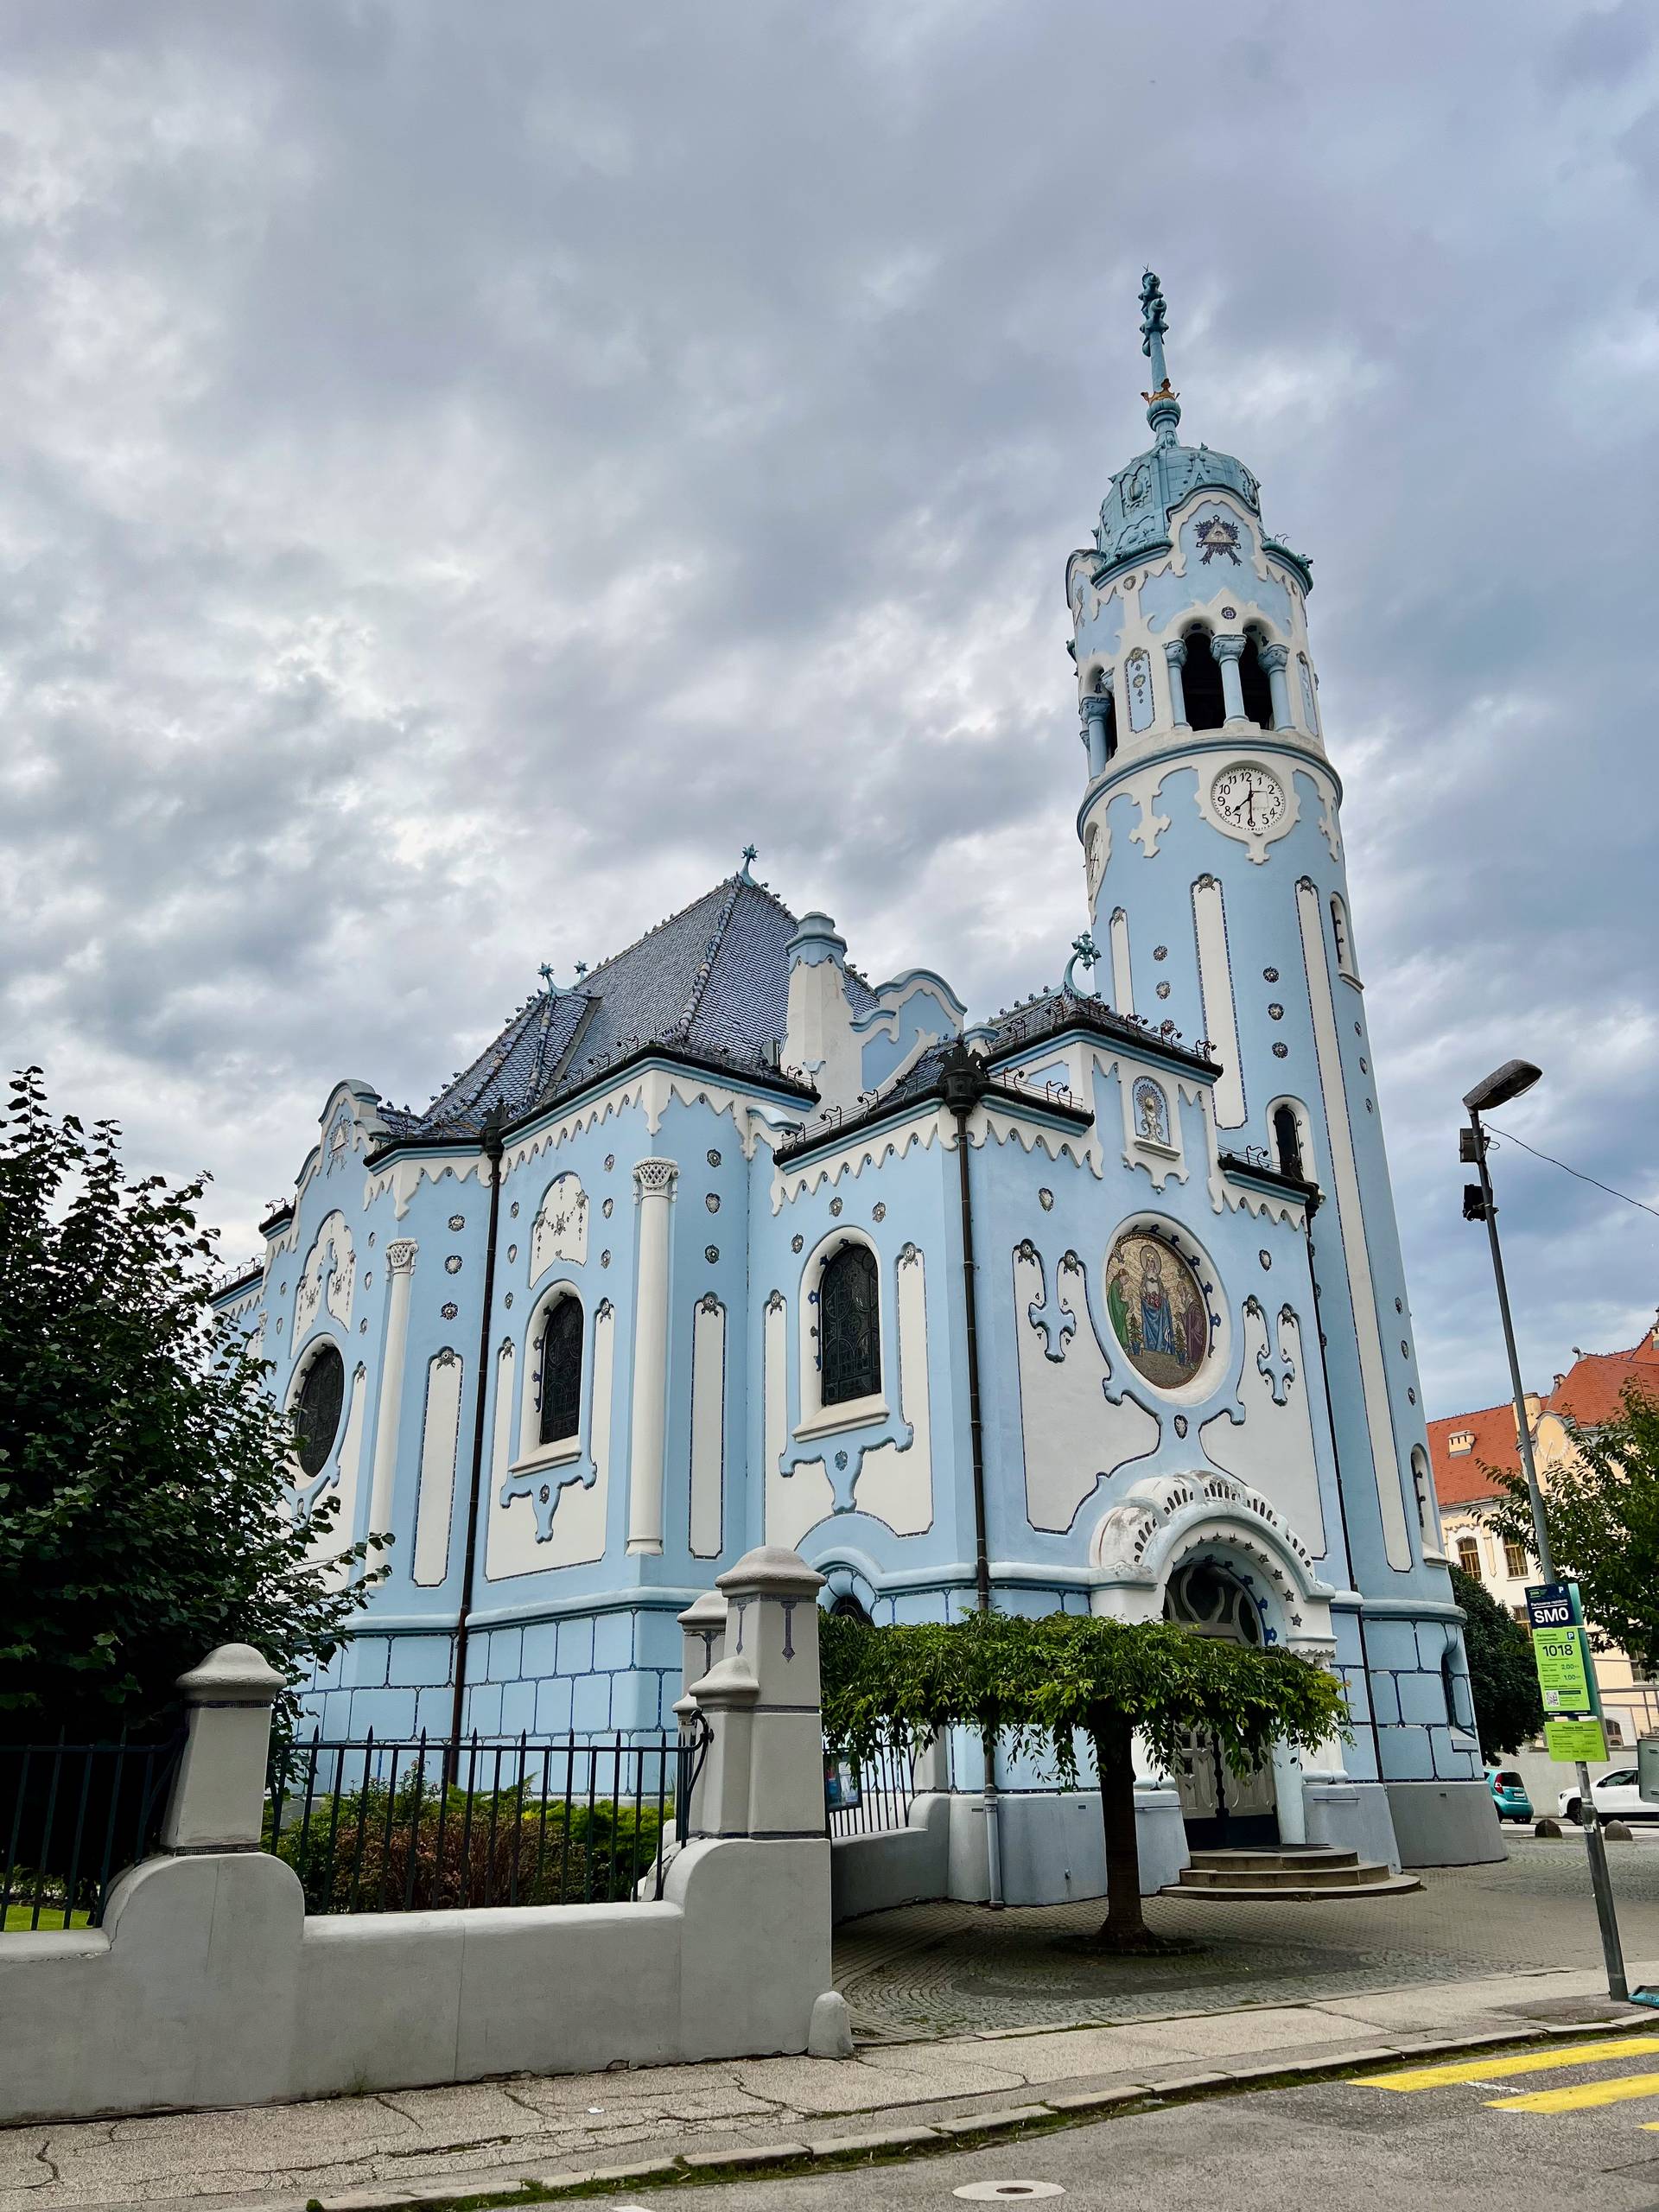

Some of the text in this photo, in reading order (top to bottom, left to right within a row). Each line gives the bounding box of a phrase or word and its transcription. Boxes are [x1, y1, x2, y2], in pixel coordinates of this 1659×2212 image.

[1228, 775, 1237, 785] 11
[1239, 772, 1252, 782] 12
[1257, 777, 1262, 785] 1
[1219, 784, 1230, 795] 10
[1268, 784, 1275, 795] 2
[1217, 796, 1225, 806] 9
[1274, 796, 1281, 807] 3
[1224, 805, 1231, 817] 8
[1269, 807, 1278, 819] 4
[1234, 813, 1241, 824] 7
[1262, 813, 1269, 824] 5
[1541, 1644, 1573, 1656] 1018
